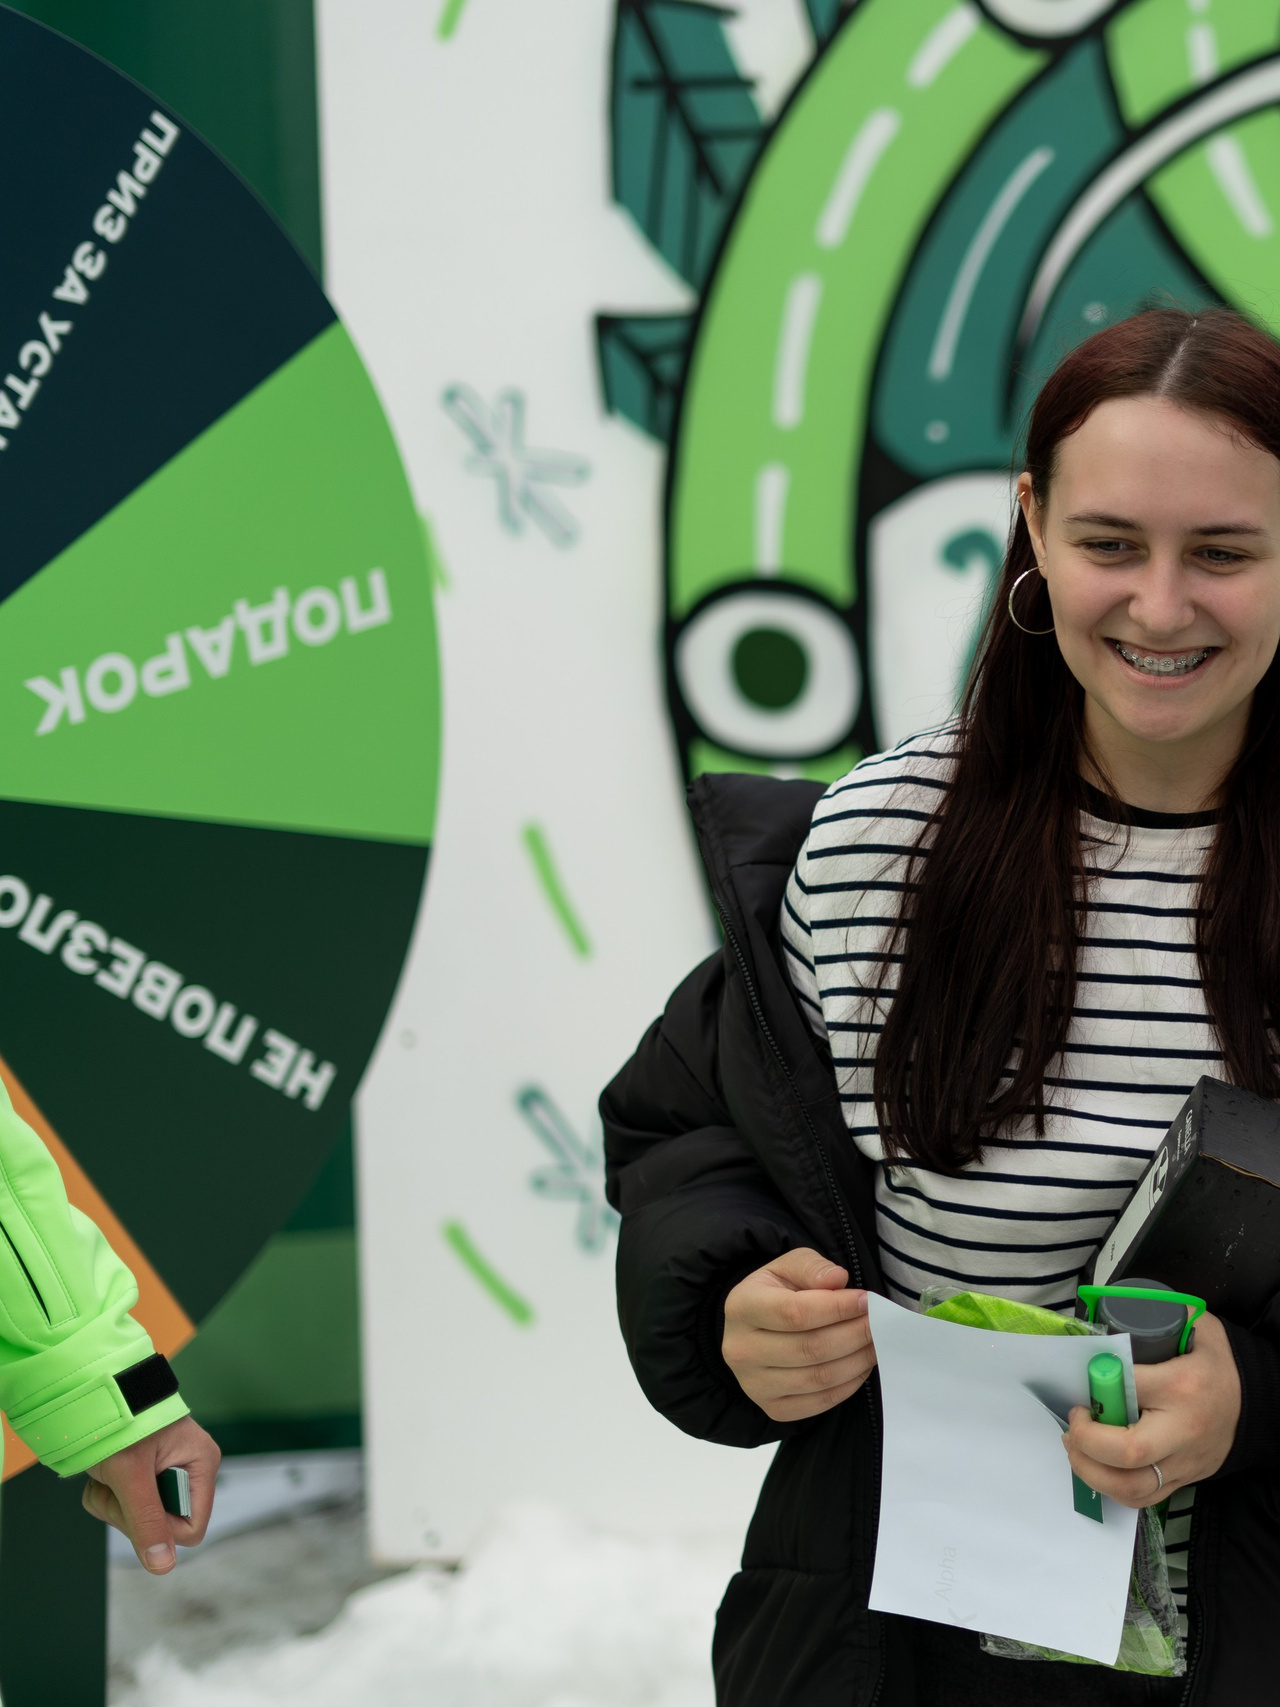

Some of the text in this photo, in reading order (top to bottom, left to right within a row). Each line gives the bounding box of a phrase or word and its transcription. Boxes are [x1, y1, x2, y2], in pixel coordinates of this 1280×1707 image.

[0, 111, 179, 450] ПРИЗ ЗА УСТА
[25, 568, 392, 736] ПОДАРОК
[0, 874, 336, 1111] НЕ ПОВЕЗЛО
[933, 1546, 958, 1602] Alpha
